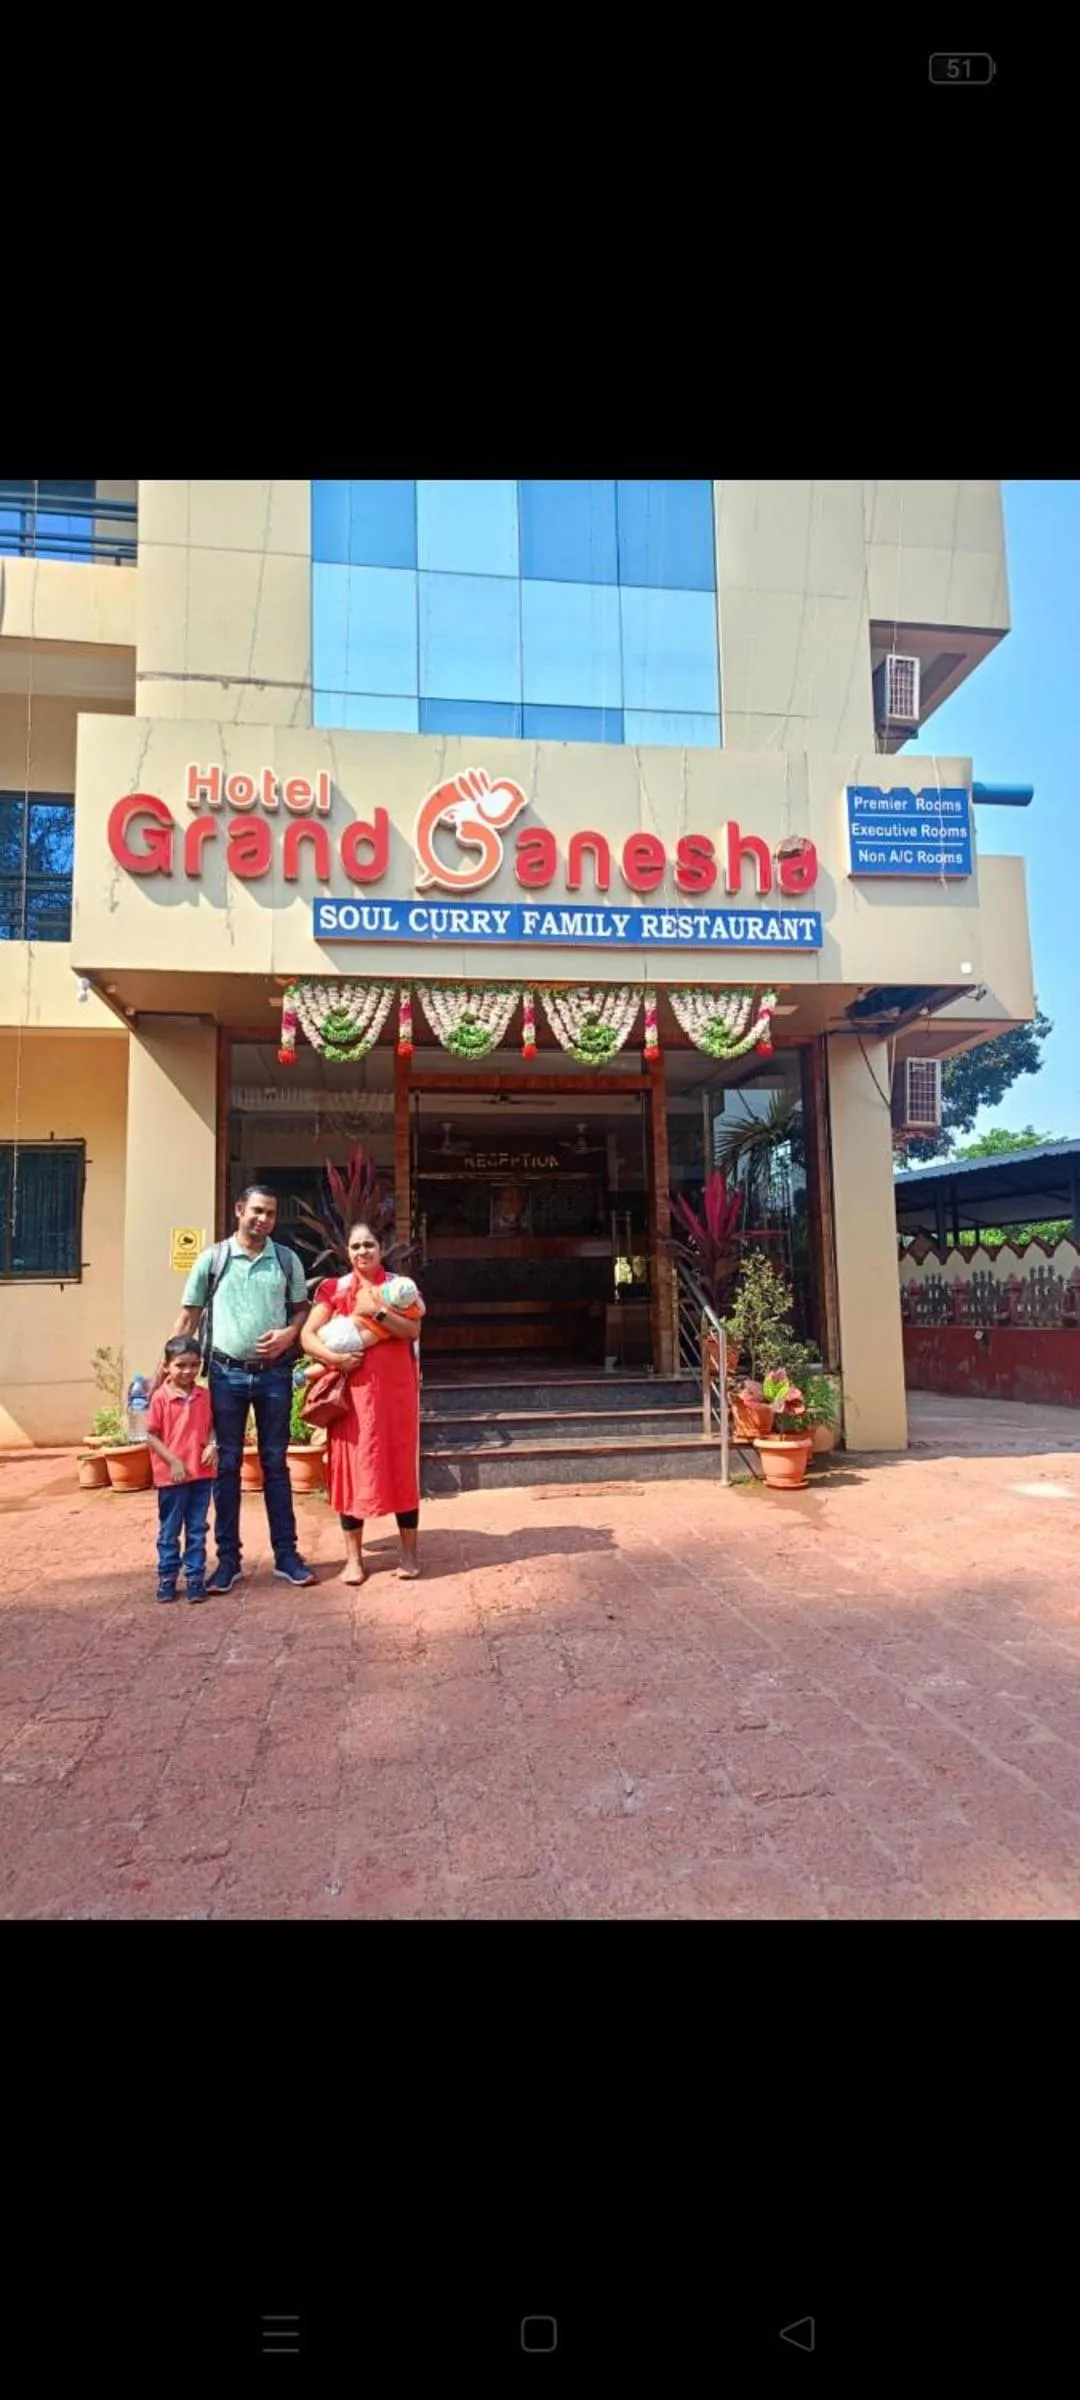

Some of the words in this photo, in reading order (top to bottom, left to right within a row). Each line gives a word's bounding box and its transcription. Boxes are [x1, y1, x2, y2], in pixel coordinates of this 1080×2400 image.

[186, 764, 332, 815] Hotel
[853, 795, 908, 811] Premier
[915, 797, 962, 812] Rooms
[107, 793, 391, 882] Grand
[851, 822, 918, 838] Executive
[921, 824, 968, 839] Rooms
[858, 848, 886, 863] Non
[889, 849, 914, 863] A/C
[917, 850, 963, 865] Rooms
[319, 904, 399, 932] SOUL
[408, 907, 511, 934] CURRY
[522, 911, 630, 938] FAMILY
[641, 914, 817, 942] RESTAURANT
